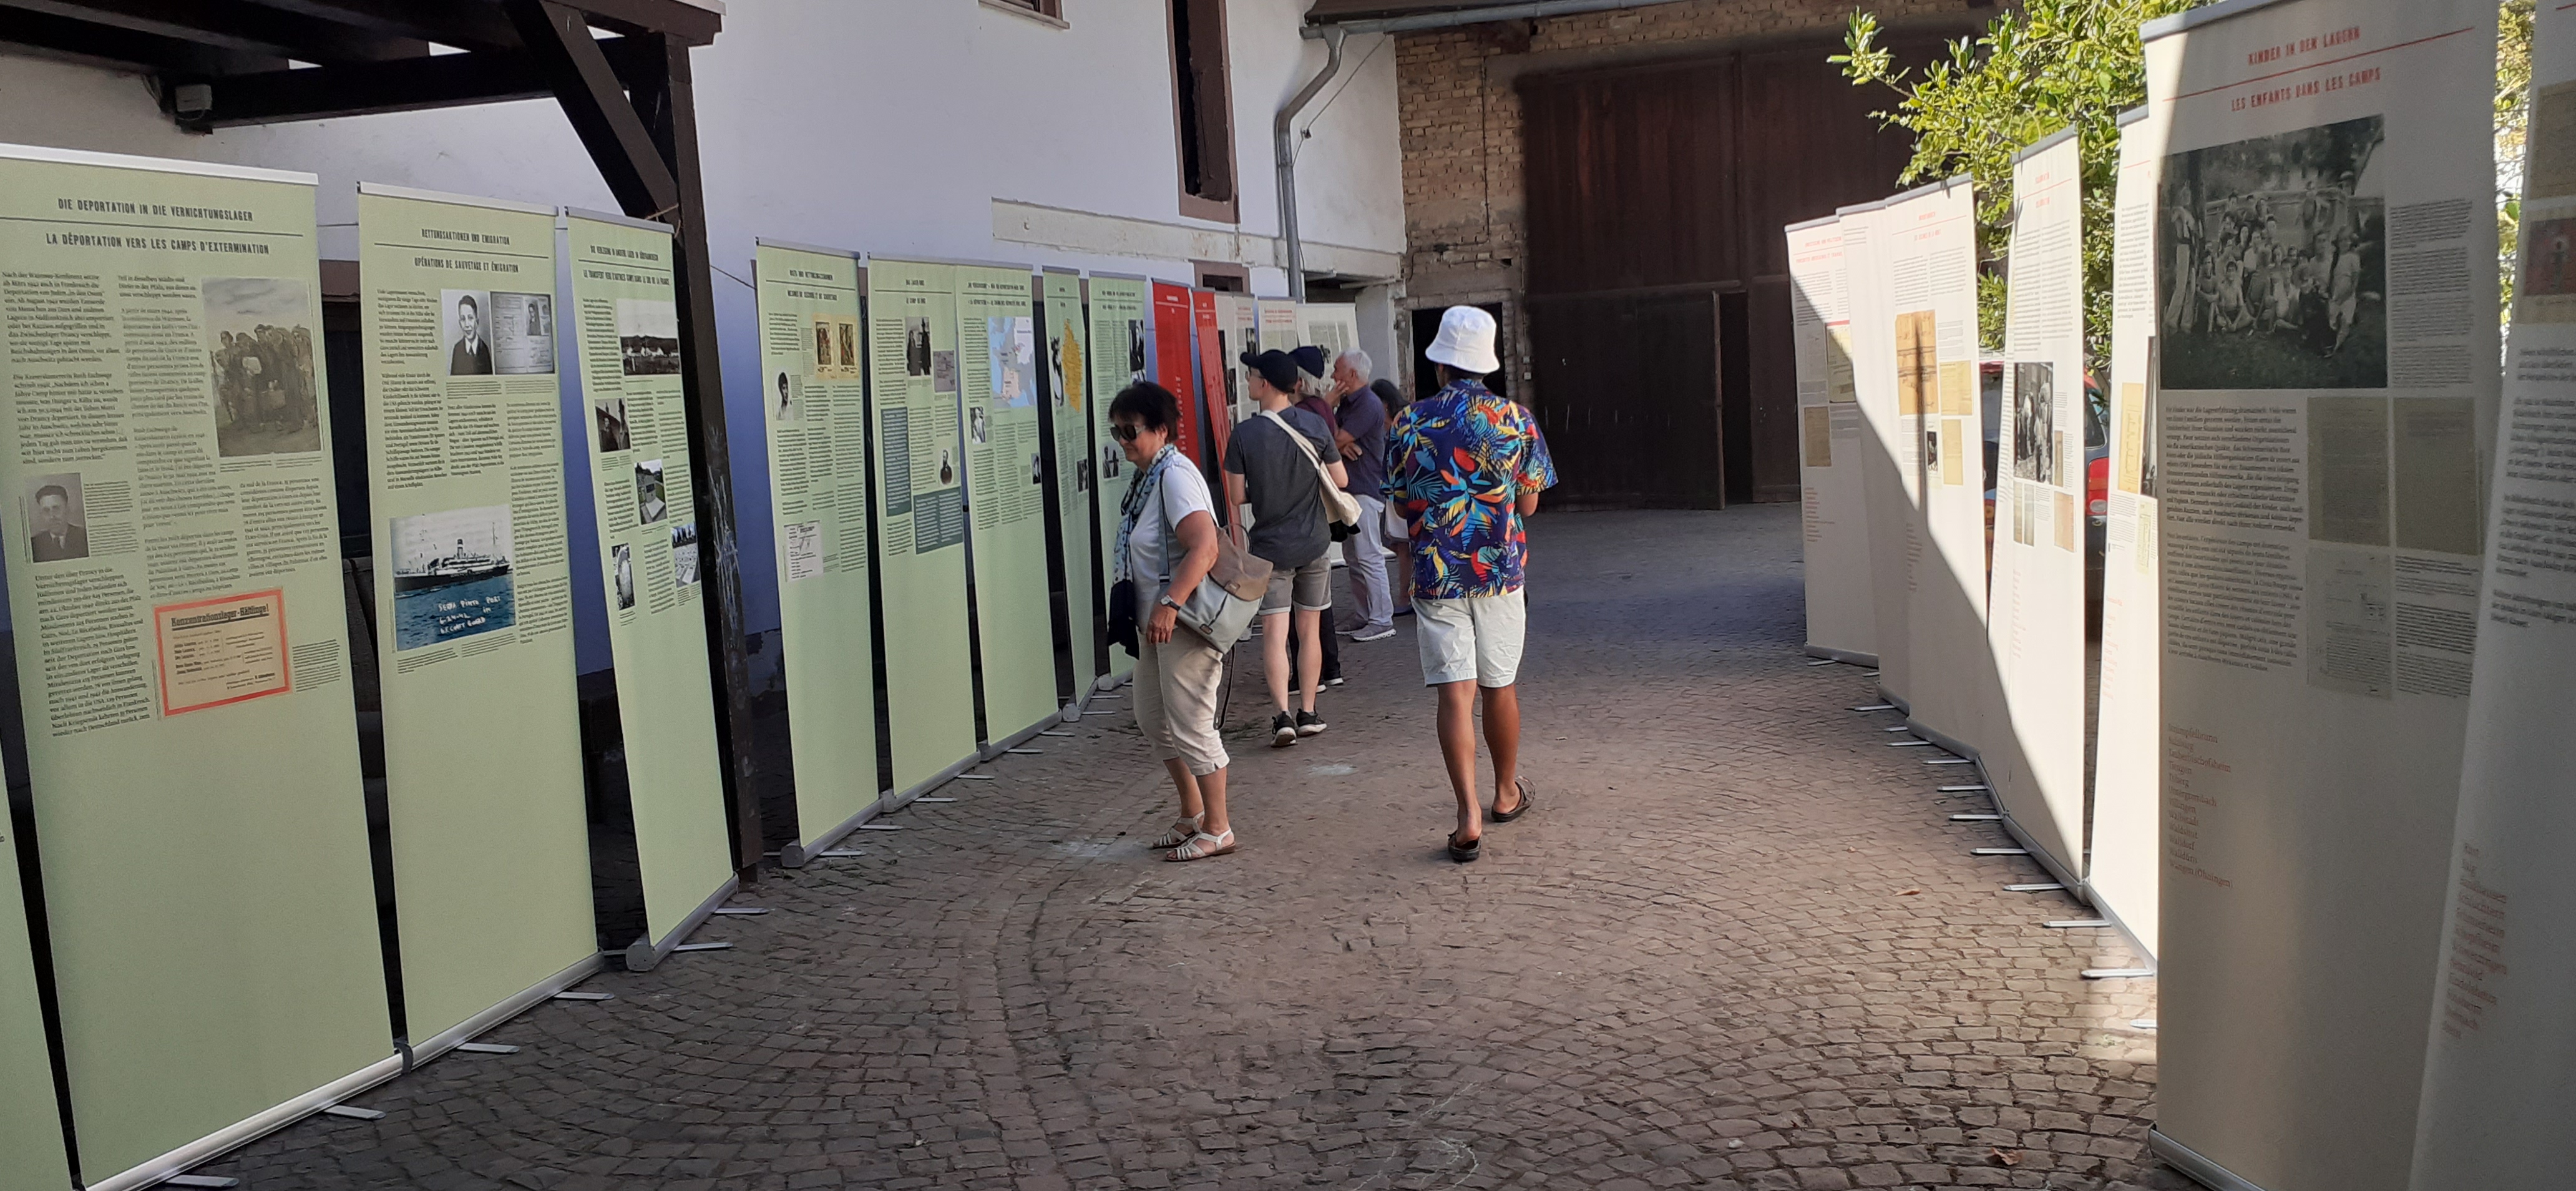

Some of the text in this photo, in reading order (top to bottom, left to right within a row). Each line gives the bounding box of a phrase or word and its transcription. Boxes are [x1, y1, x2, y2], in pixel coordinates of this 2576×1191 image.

[2286, 42, 2295, 55] IN
[2232, 67, 2380, 112] LES ENFANTS DANS LES CAMPS
[57, 198, 253, 221] DIE DEPORTATION IN DIE VERNICHTUNGSLAGER
[46, 232, 270, 255] LA DÉPORTATION VERS LES CAMPS D'EXTERMINATION
[482, 235, 510, 245] EMIGRATION
[446, 260, 452, 268] DE
[484, 262, 489, 271] ET
